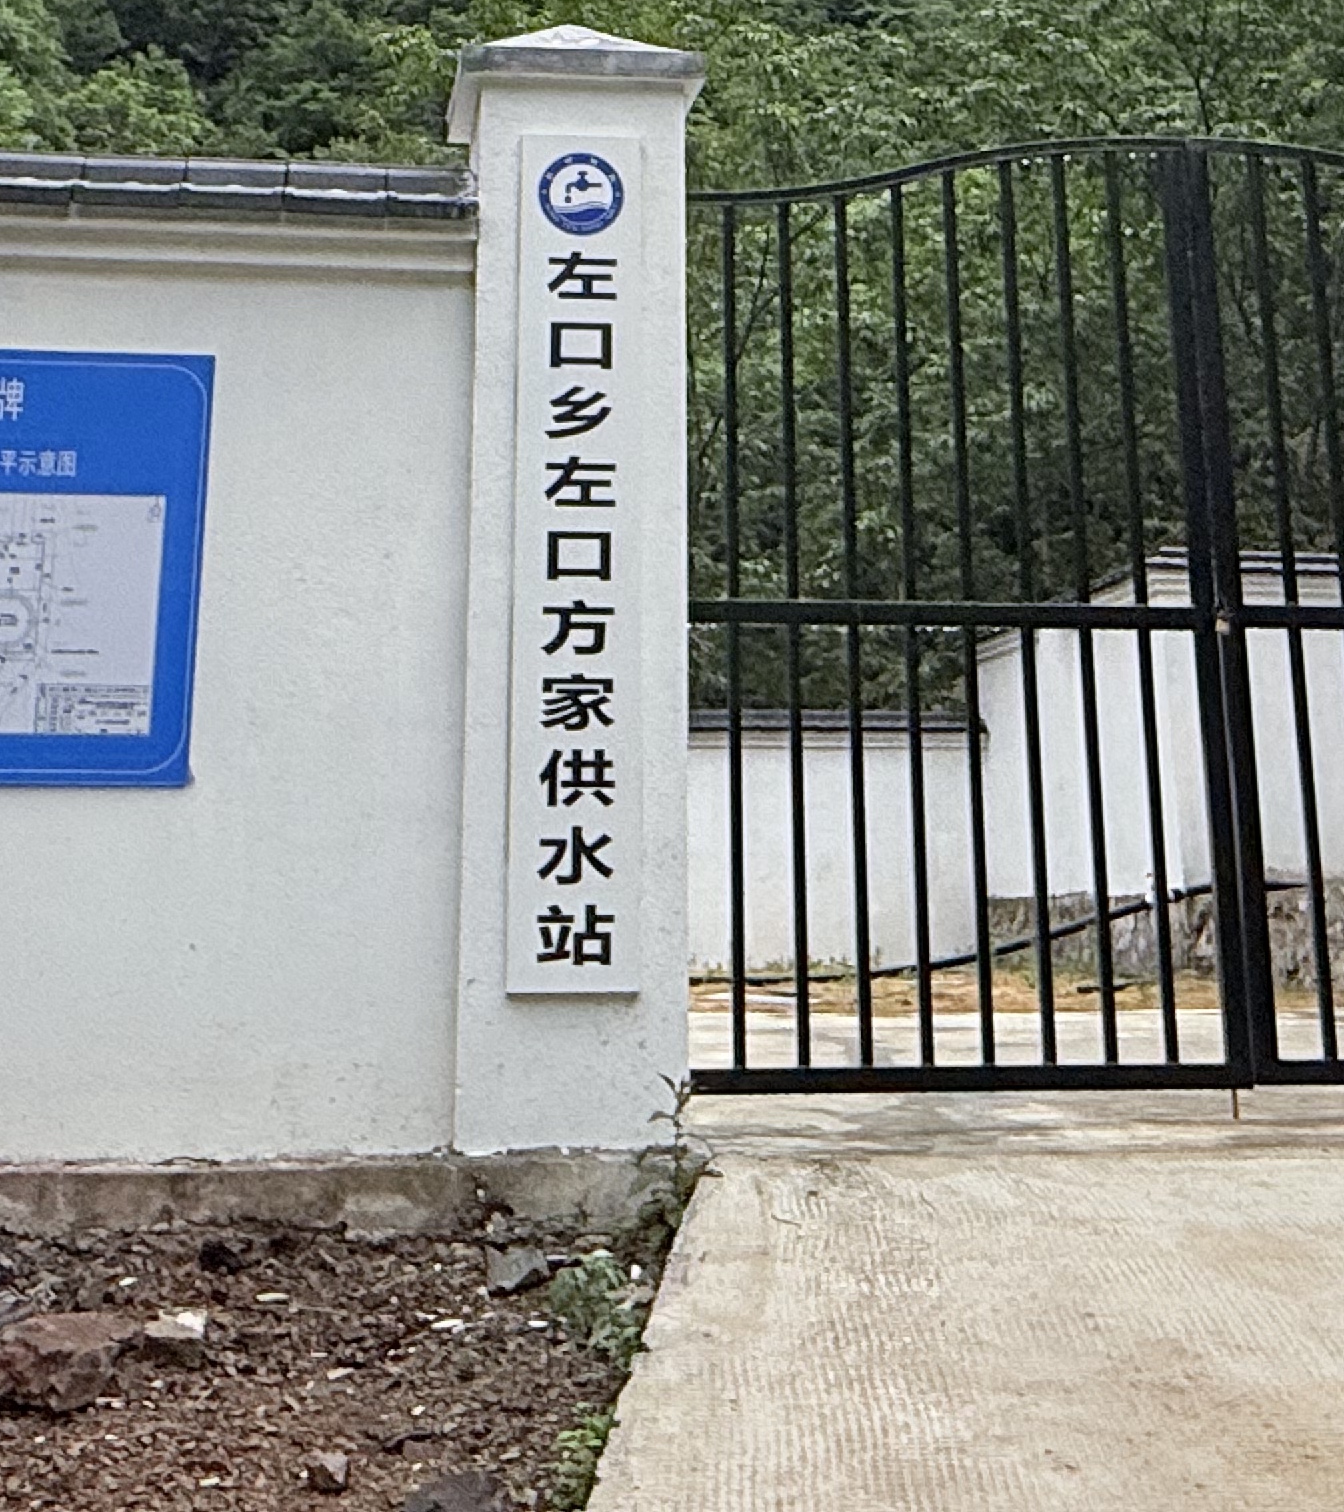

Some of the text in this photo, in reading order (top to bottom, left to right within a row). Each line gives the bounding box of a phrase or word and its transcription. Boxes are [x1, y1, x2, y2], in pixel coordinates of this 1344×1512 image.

[536, 252, 618, 967] 左口乡左口方家供水站
